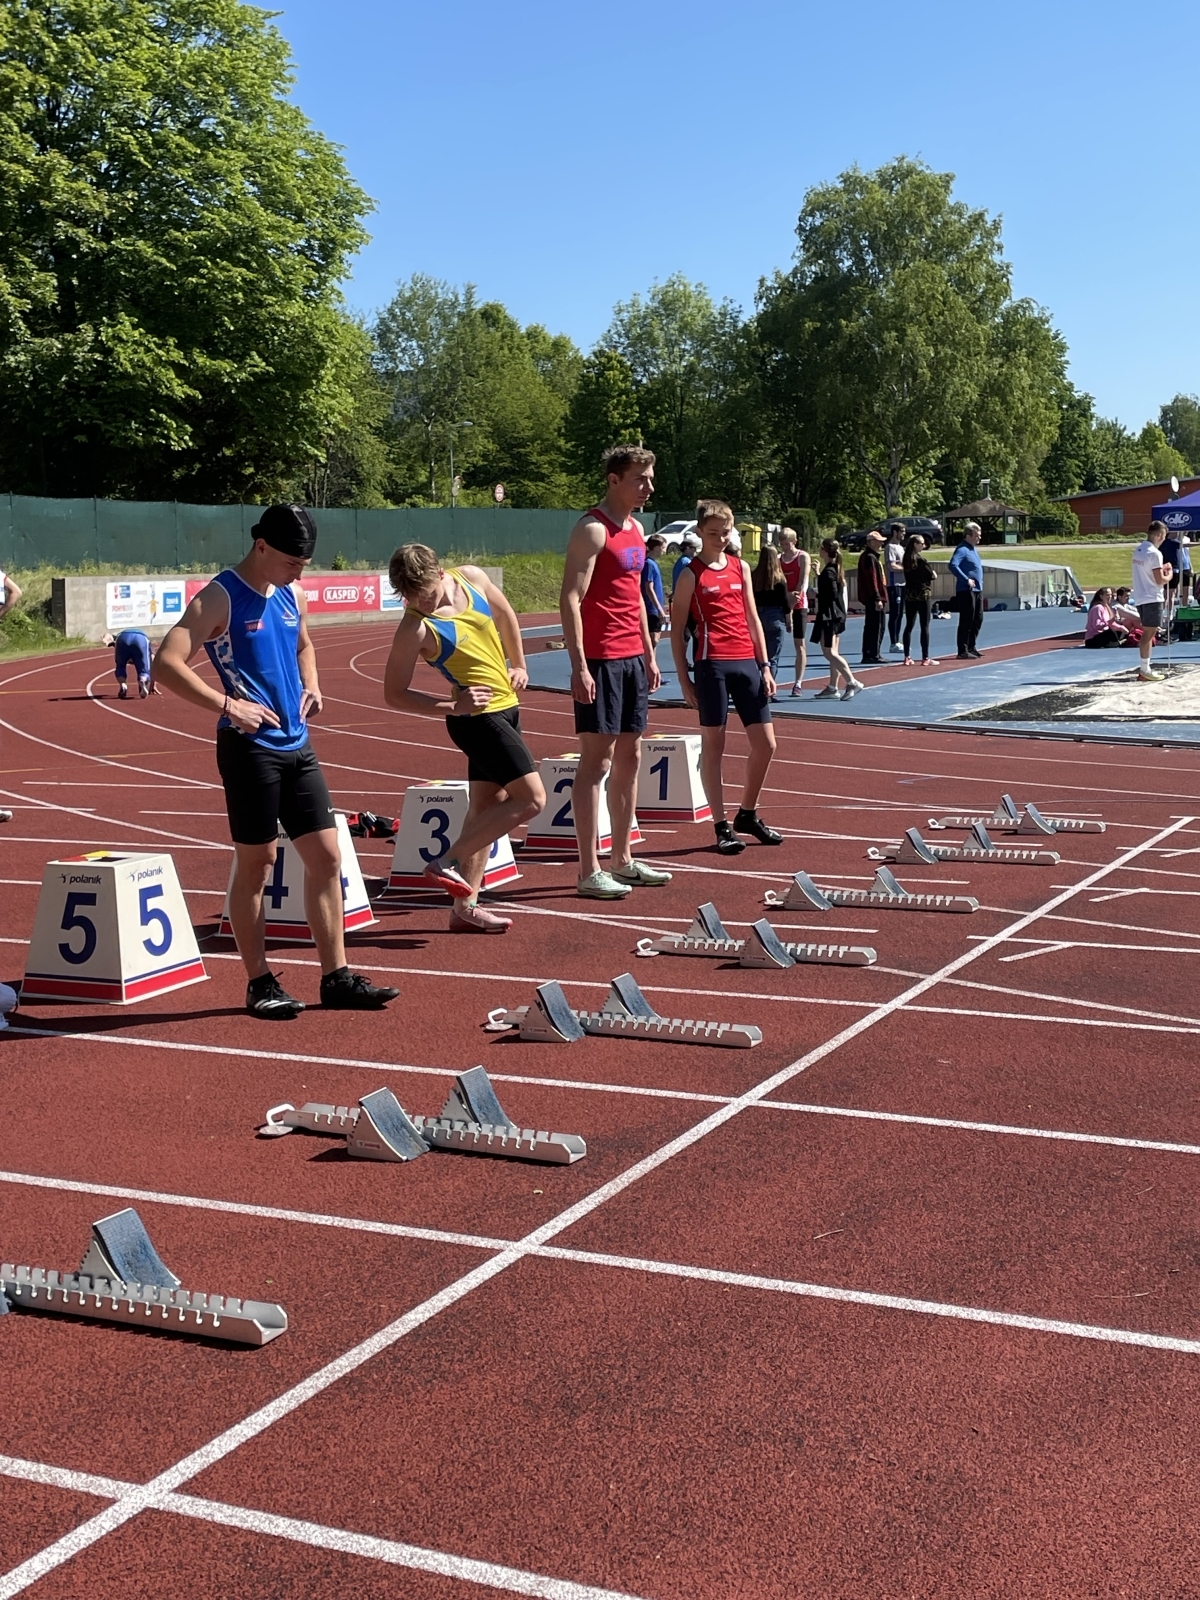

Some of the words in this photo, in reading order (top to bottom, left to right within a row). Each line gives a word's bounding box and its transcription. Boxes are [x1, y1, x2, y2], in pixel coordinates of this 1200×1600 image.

[326, 589, 357, 601] KASPER
[363, 586, 375, 600] 25
[558, 766, 578, 774] polan
[650, 756, 669, 801] 1
[426, 794, 455, 804] polanik
[551, 778, 575, 827] 2
[418, 808, 451, 863] 3
[69, 875, 102, 885] polanik
[137, 866, 163, 882] polanik
[58, 891, 98, 965] 5
[138, 883, 173, 957] 5
